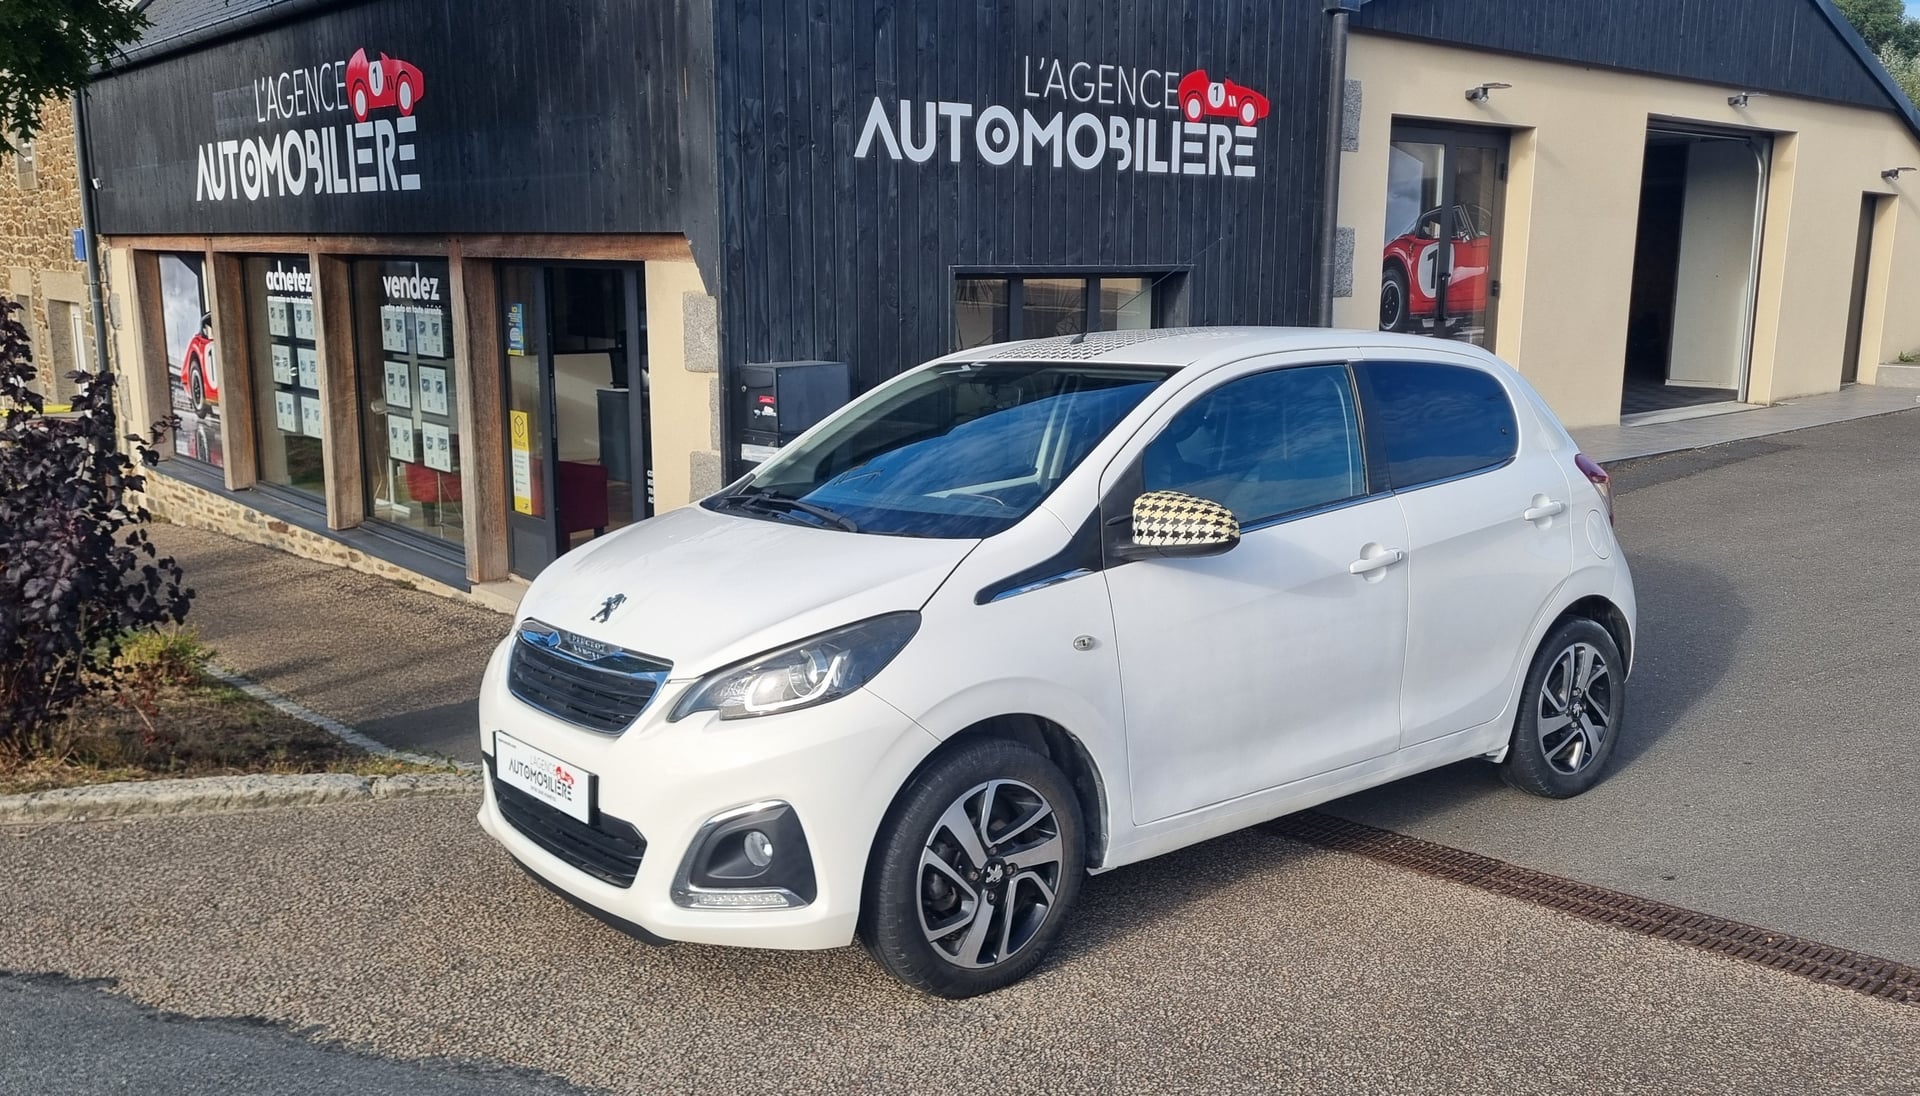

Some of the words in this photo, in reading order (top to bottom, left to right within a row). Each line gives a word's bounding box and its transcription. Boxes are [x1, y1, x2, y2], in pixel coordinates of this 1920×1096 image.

[254, 61, 349, 122] L'AGENCE
[1024, 55, 1180, 110] L'AGENCE
[265, 259, 313, 292] achetez
[382, 262, 440, 301] vendez
